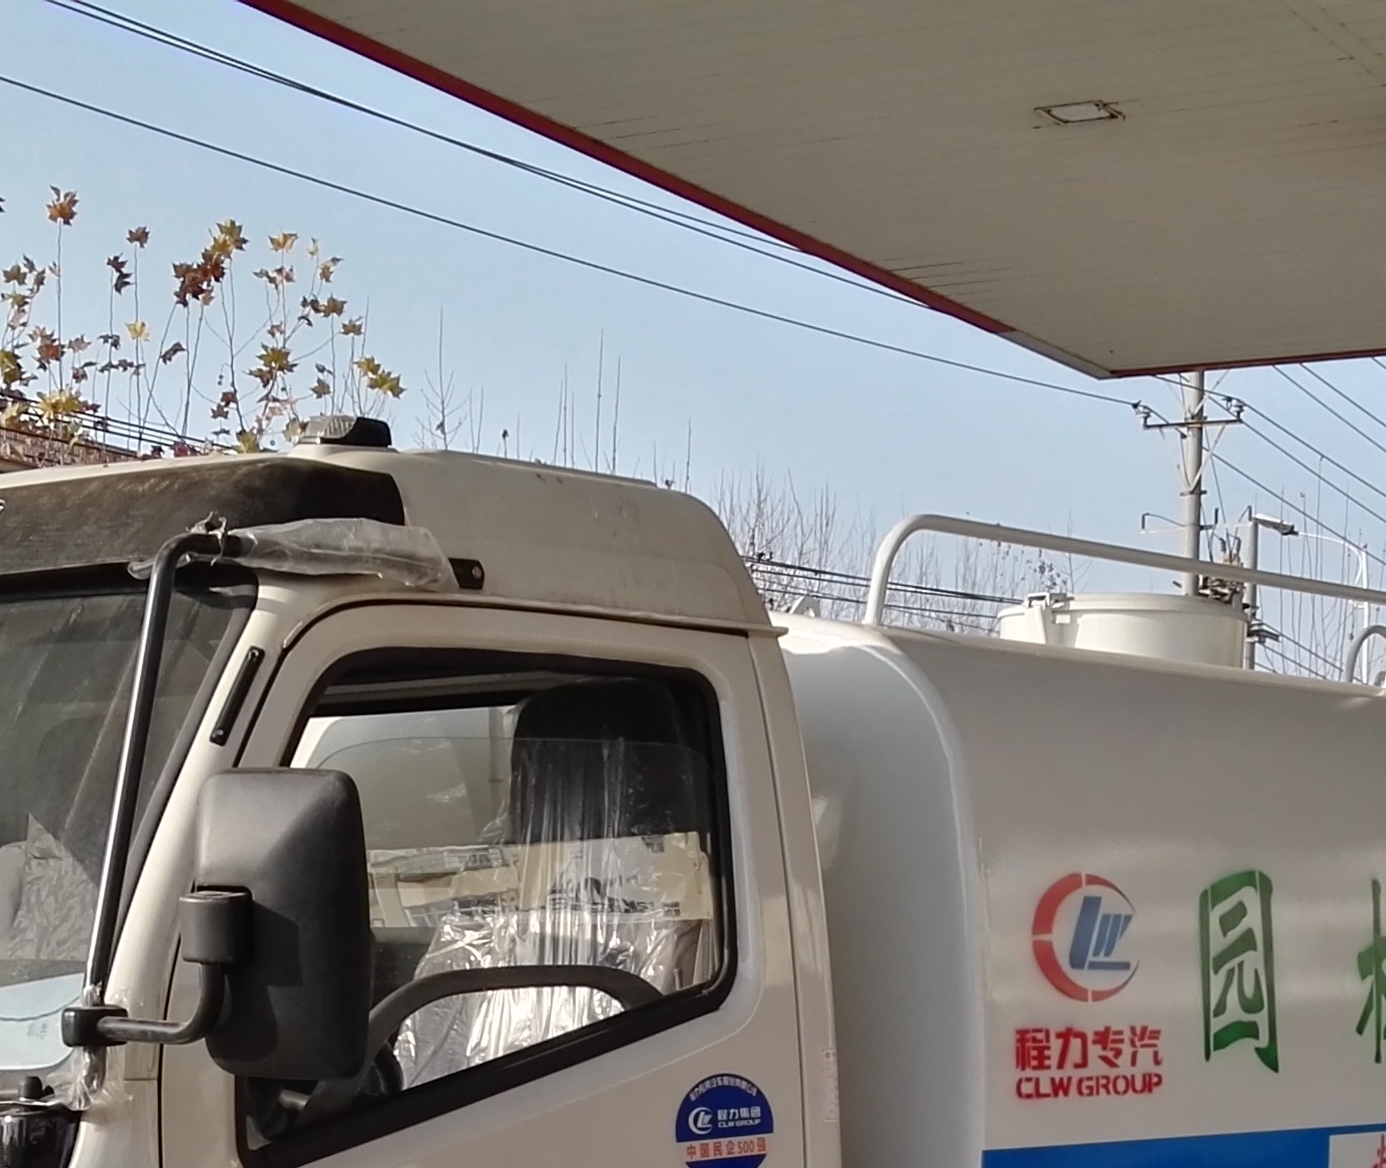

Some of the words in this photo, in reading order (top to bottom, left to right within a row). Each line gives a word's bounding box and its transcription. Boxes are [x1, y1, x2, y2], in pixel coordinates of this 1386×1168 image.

[1015, 1025, 1163, 1072] 程力专汽
[1015, 1075, 1073, 1099] CLW
[1076, 1072, 1163, 1098] GROUP
[716, 1105, 761, 1121] 程力集团
[735, 1118, 762, 1127] GROUP
